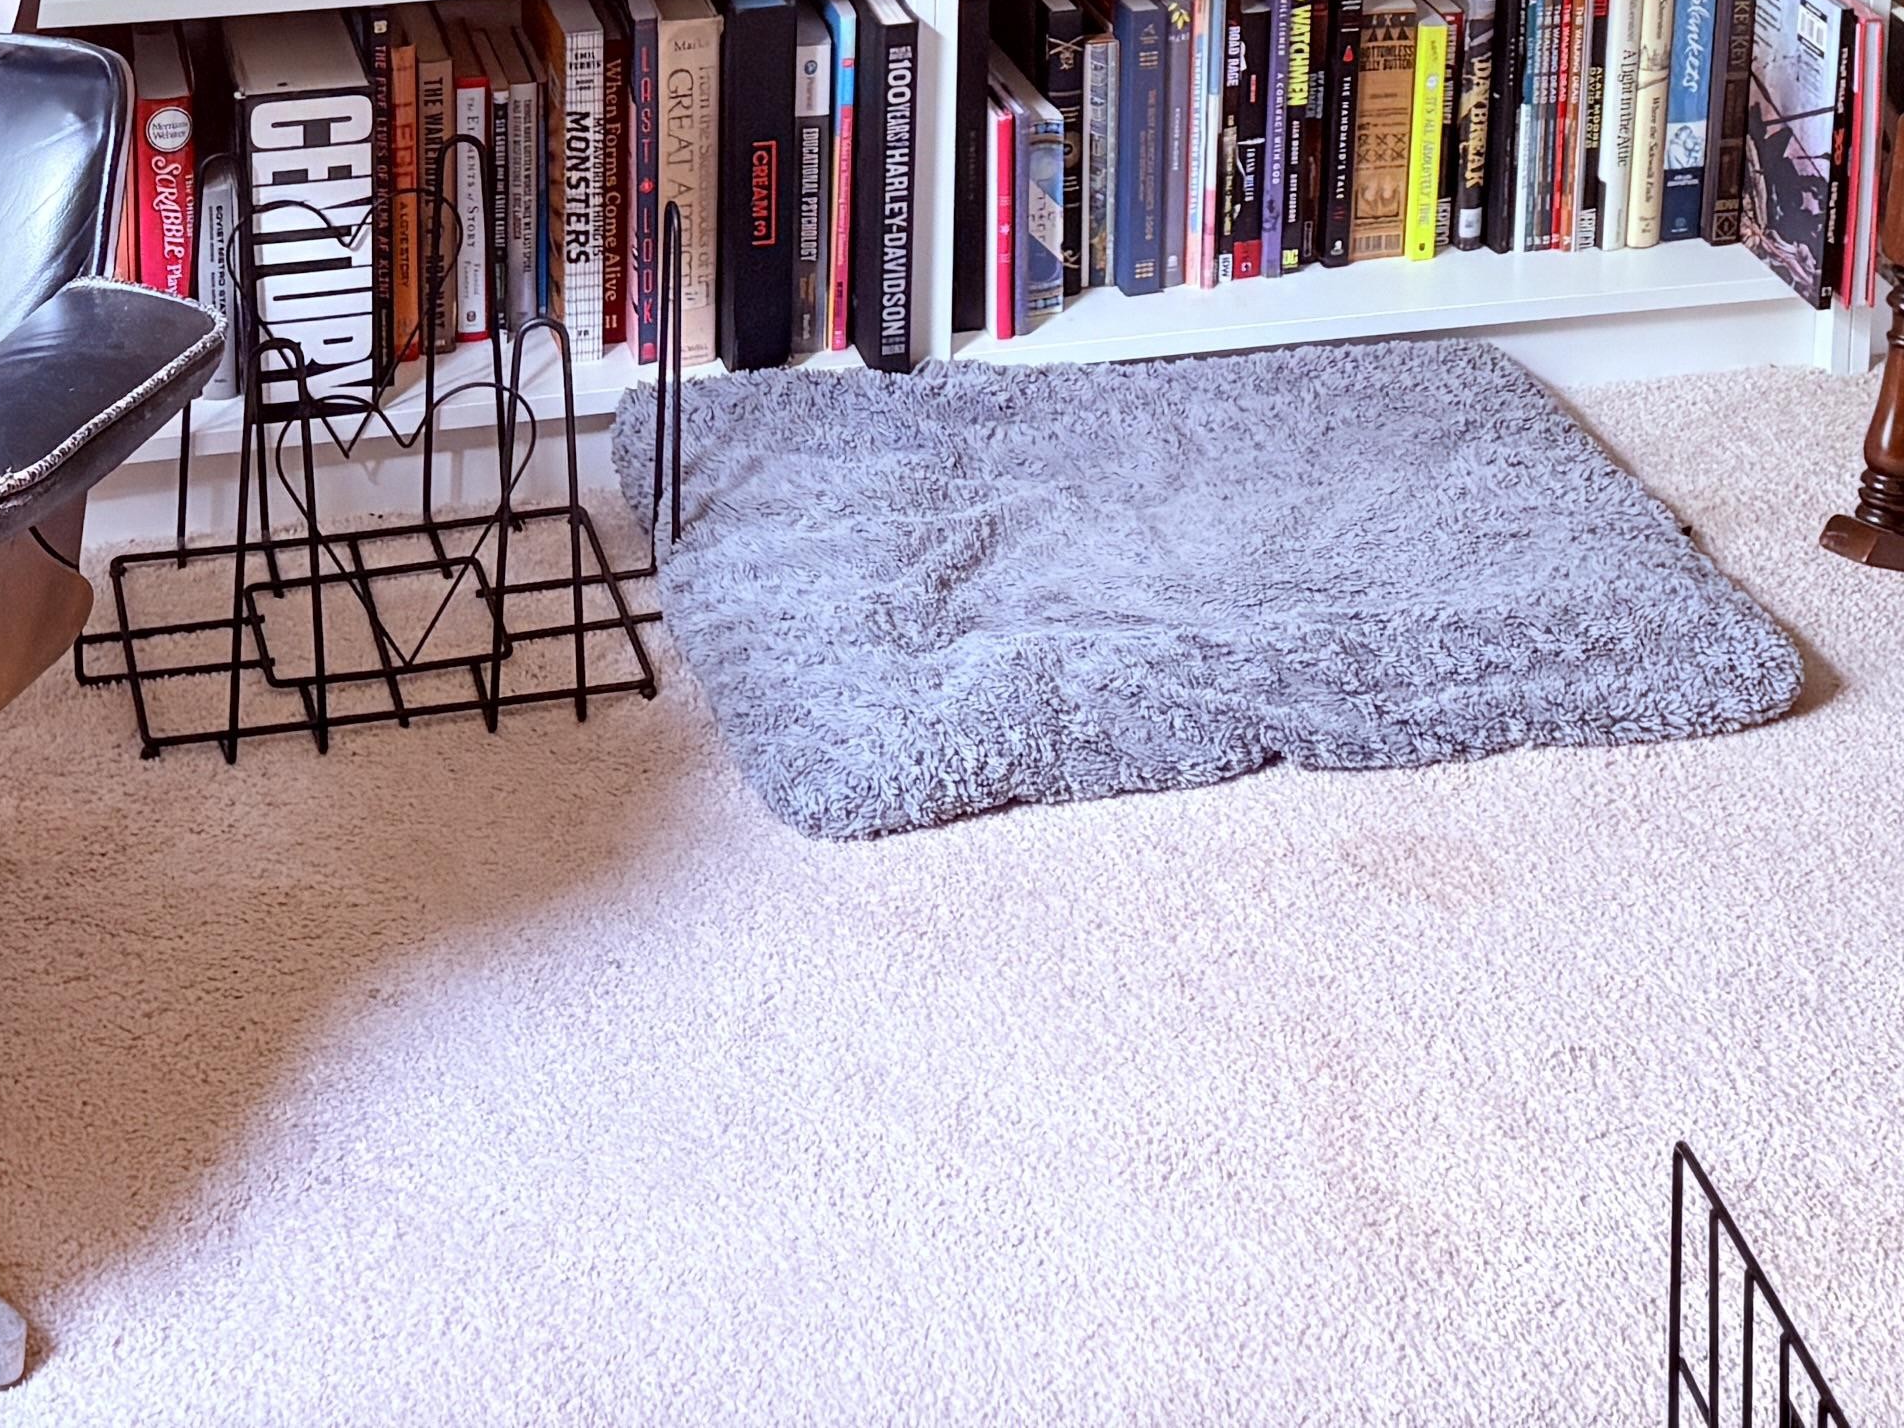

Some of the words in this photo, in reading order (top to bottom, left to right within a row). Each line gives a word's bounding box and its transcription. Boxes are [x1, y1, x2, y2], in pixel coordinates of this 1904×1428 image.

[1288, 3, 1312, 106] WATCHMEN
[1464, 54, 1492, 189] DAYBREAK
[565, 111, 592, 265] MONSTERS
[605, 192, 622, 248] Come
[604, 252, 621, 302] Alive
